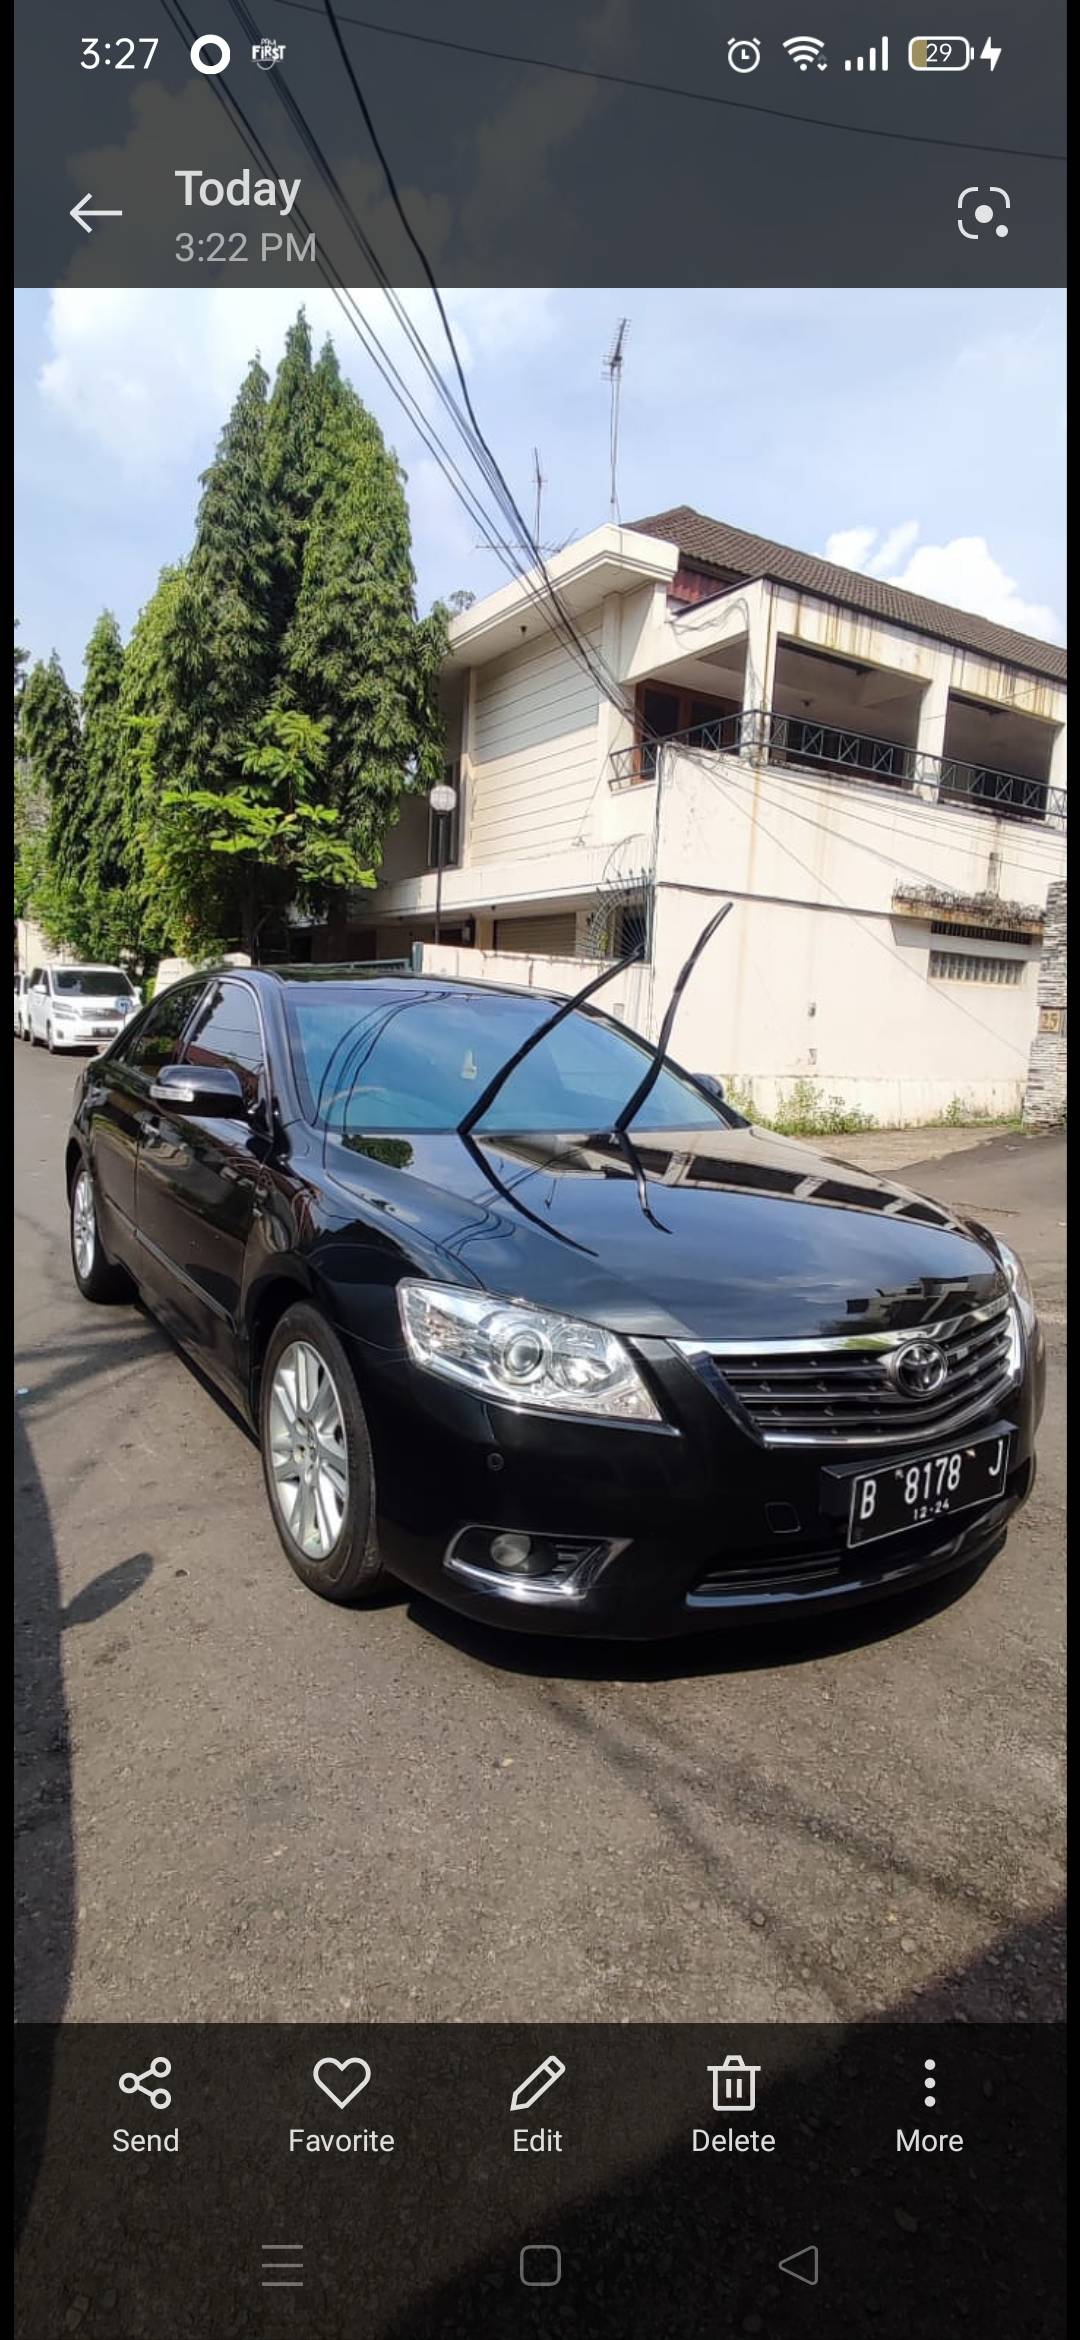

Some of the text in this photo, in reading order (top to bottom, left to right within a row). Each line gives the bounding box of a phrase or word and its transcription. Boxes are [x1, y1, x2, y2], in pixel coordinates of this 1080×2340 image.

[859, 1439, 1004, 1520] B 8178 J
